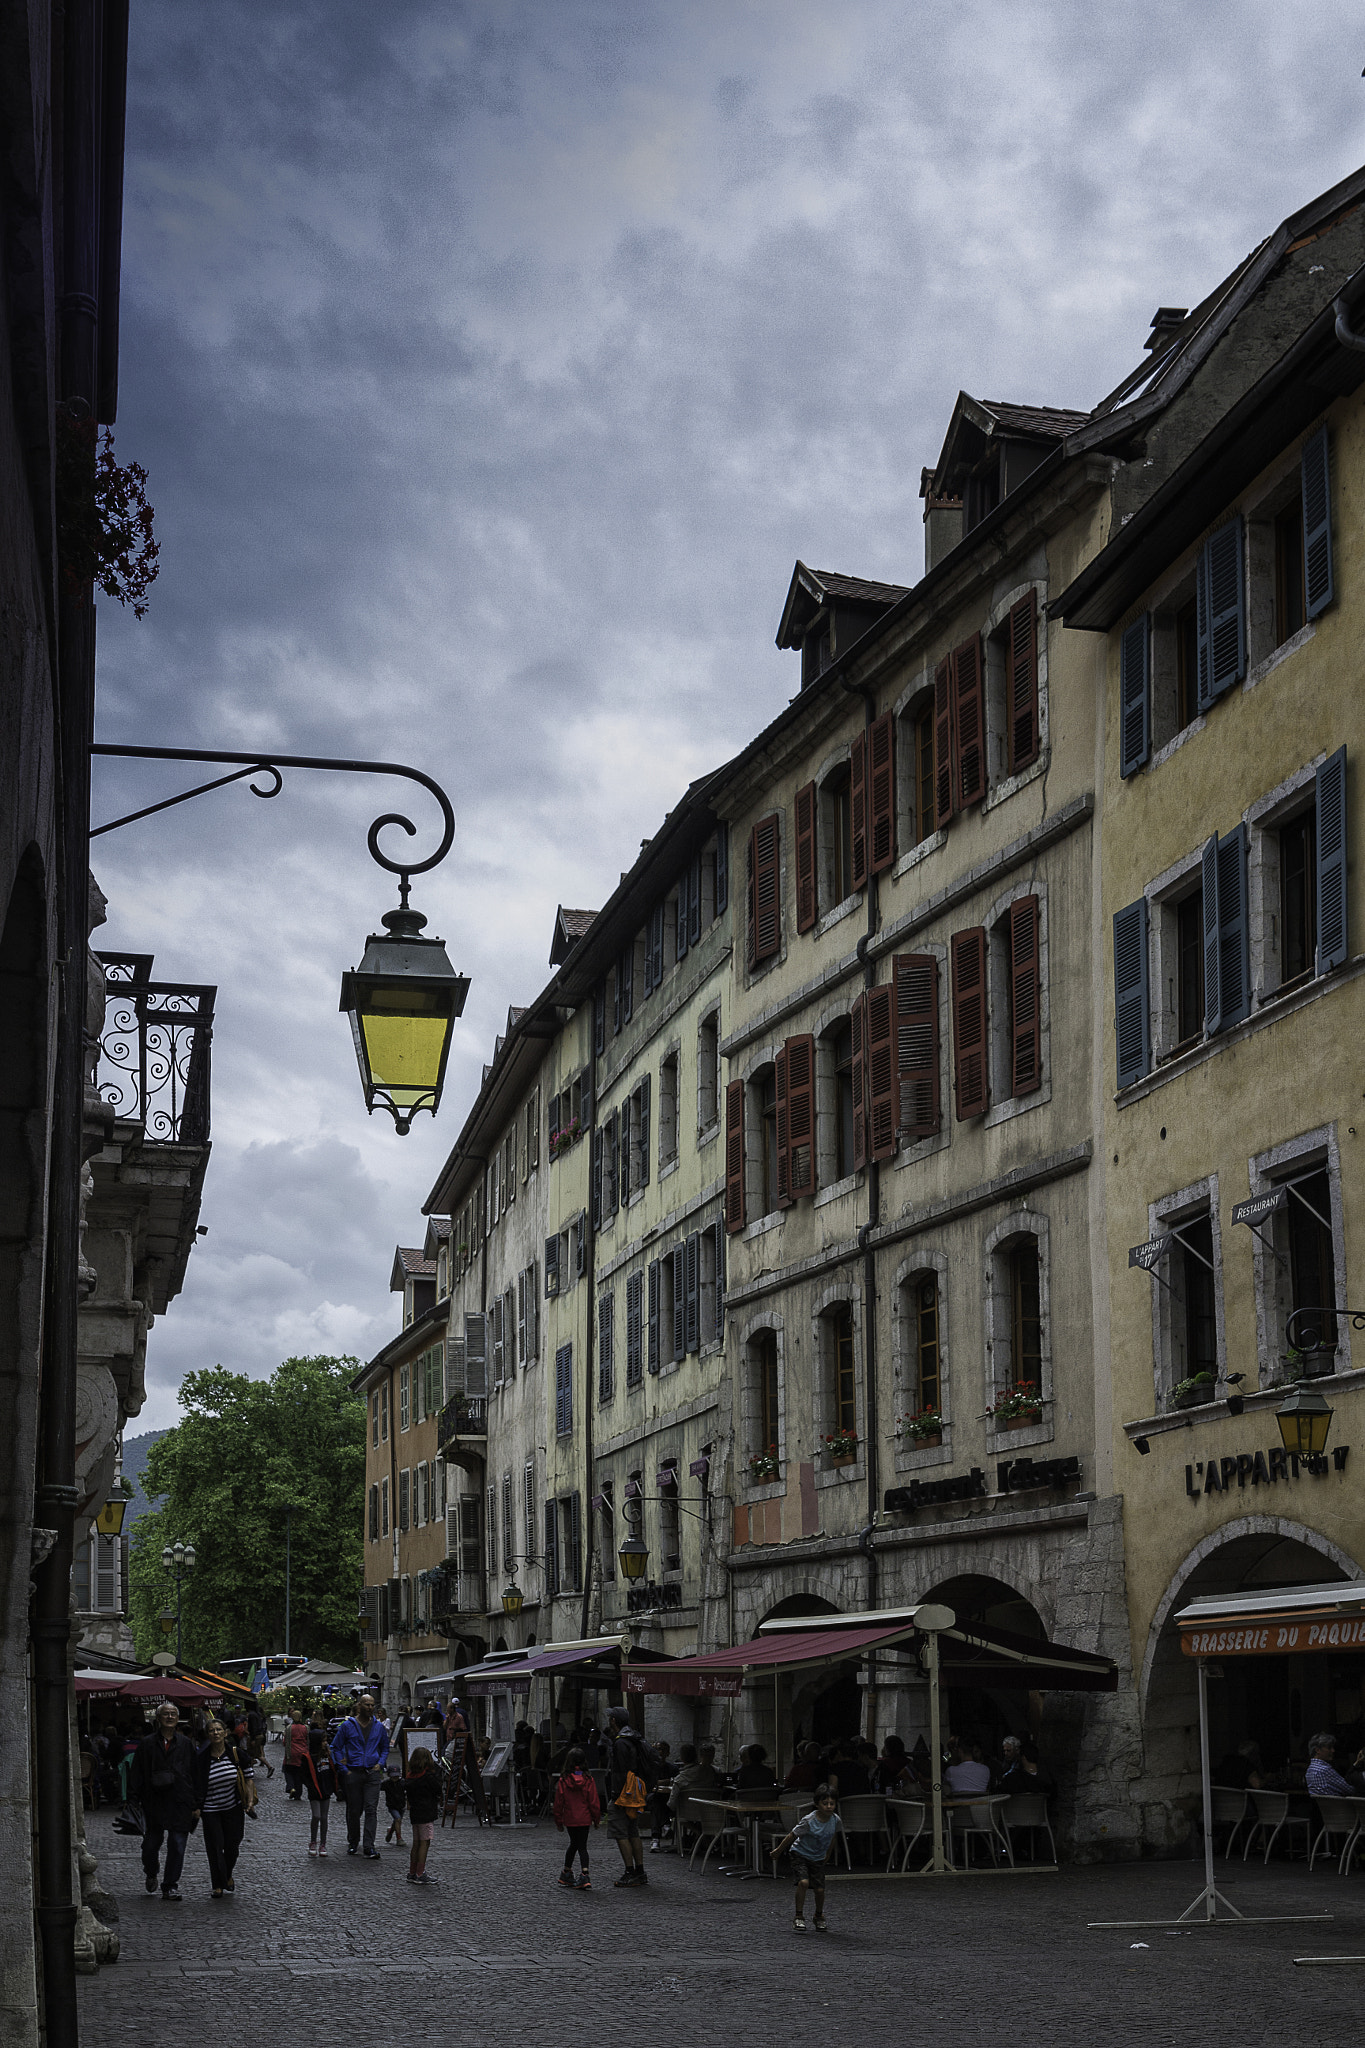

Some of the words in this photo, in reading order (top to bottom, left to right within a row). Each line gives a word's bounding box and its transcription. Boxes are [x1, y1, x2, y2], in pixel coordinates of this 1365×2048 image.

[1237, 1195, 1279, 1219] RESTAURANT
[1135, 1239, 1163, 1258] L'APPART
[1145, 1254, 1152, 1267] 17
[1191, 1630, 1269, 1653] BRASSERIE
[1277, 1627, 1299, 1648] DU
[141, 1694, 166, 1702] NAPOLI
